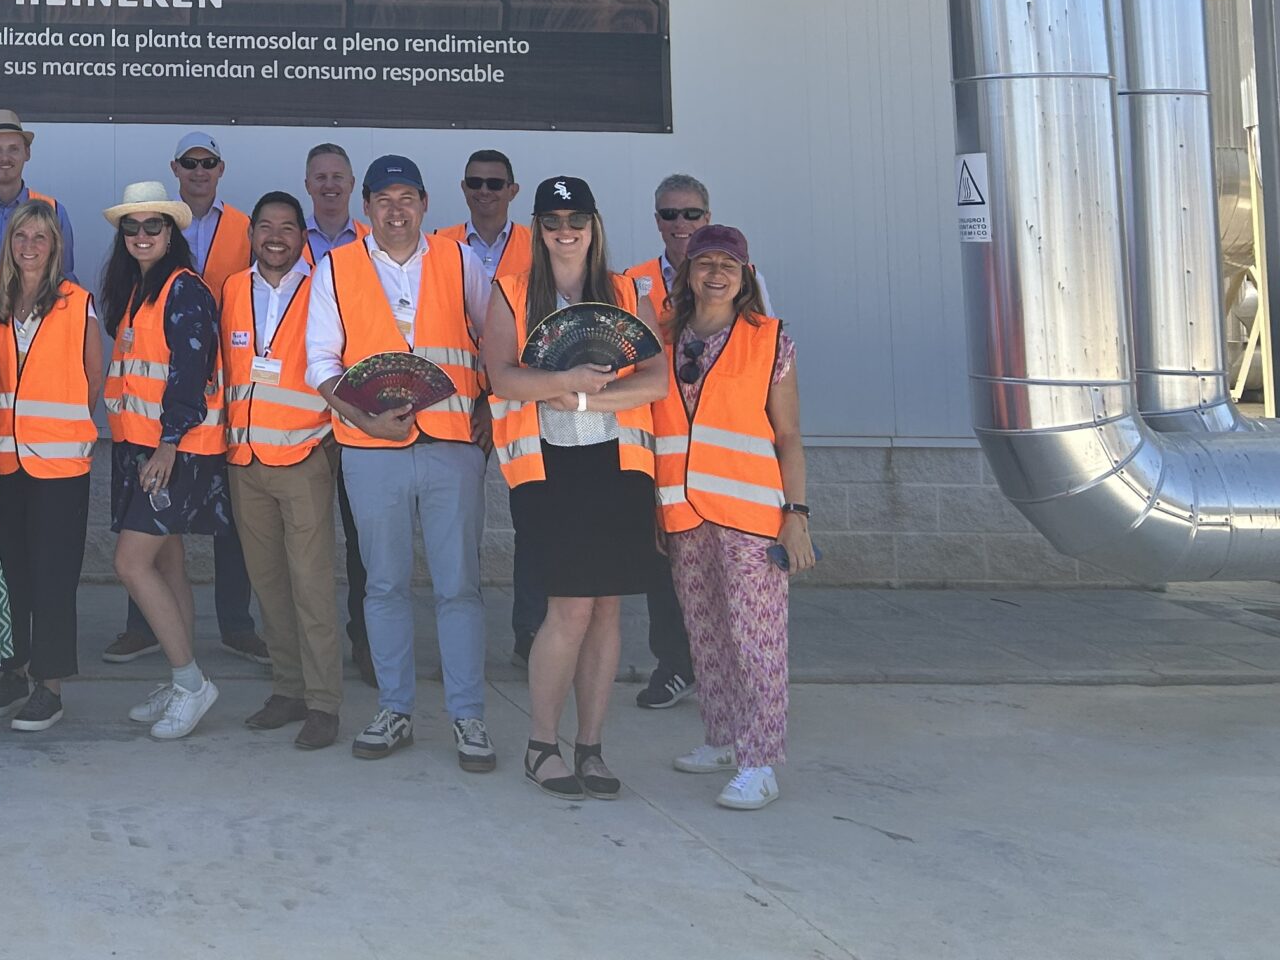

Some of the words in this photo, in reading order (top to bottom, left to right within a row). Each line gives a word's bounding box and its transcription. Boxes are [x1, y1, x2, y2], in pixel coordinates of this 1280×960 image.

[69, 33, 105, 47] con
[111, 29, 129, 48] la
[136, 29, 202, 53] planta
[207, 32, 319, 51] termosolar
[324, 37, 337, 51] a
[342, 32, 399, 56] pleno
[405, 35, 530, 55] rendimiento
[4, 59, 37, 76] sus
[42, 60, 116, 77] marcas
[122, 59, 255, 79] recomiendan
[261, 60, 278, 79] el
[284, 64, 377, 82] consumo
[382, 64, 505, 86] responsable
